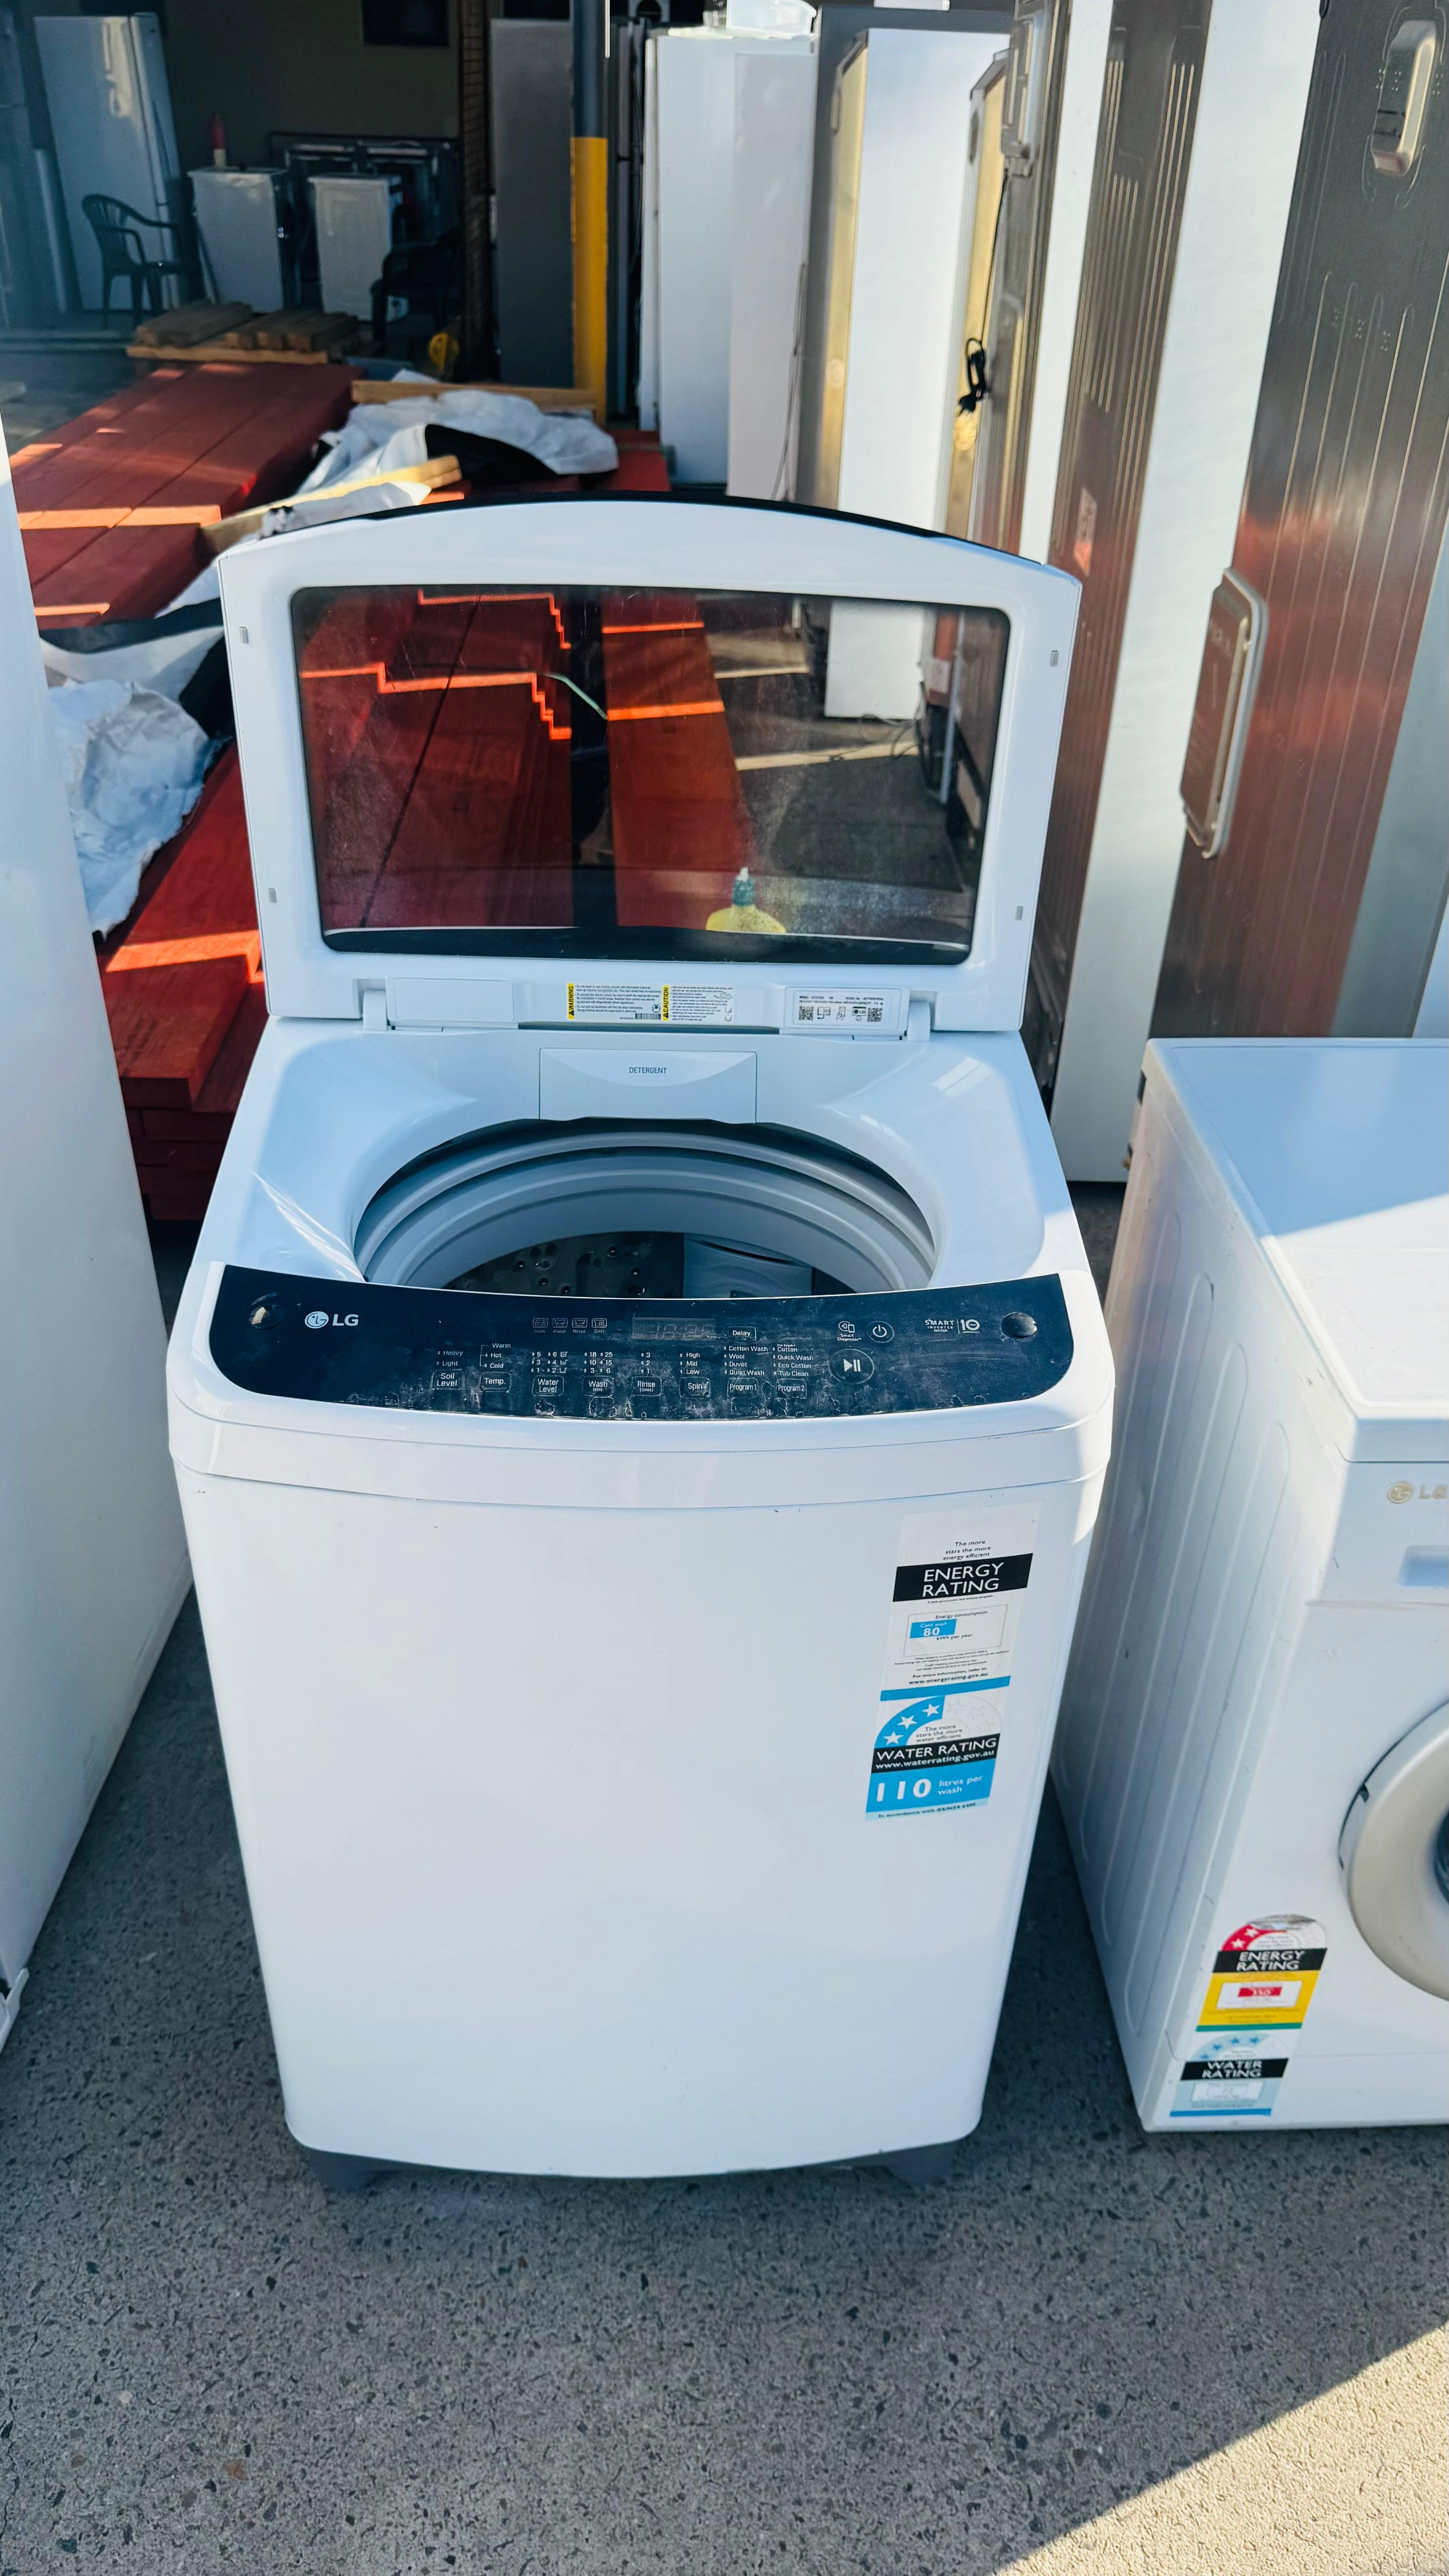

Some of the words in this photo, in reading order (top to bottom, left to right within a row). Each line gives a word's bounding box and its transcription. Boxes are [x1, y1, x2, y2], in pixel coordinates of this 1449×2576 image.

[333, 1314, 359, 1326] LG
[484, 1378, 506, 1386] Temp.
[688, 1382, 703, 1391] Spin
[778, 1384, 801, 1392] Program
[923, 1562, 1004, 1582] ENERGY
[922, 1578, 1000, 1597] RATING
[923, 1627, 940, 1637] 80
[876, 1746, 933, 1761] WATER
[938, 1738, 997, 1755] RATING
[875, 1749, 995, 1770] www.waterrating.gov.au
[939, 1778, 964, 1787] litres
[966, 1775, 984, 1785] per
[937, 1786, 962, 1795] wash
[1239, 1951, 1305, 1962] ENERGY
[1236, 1961, 1300, 1971] RATING
[1207, 2060, 1263, 2069] WATER
[1202, 2068, 1262, 2078] RATING
